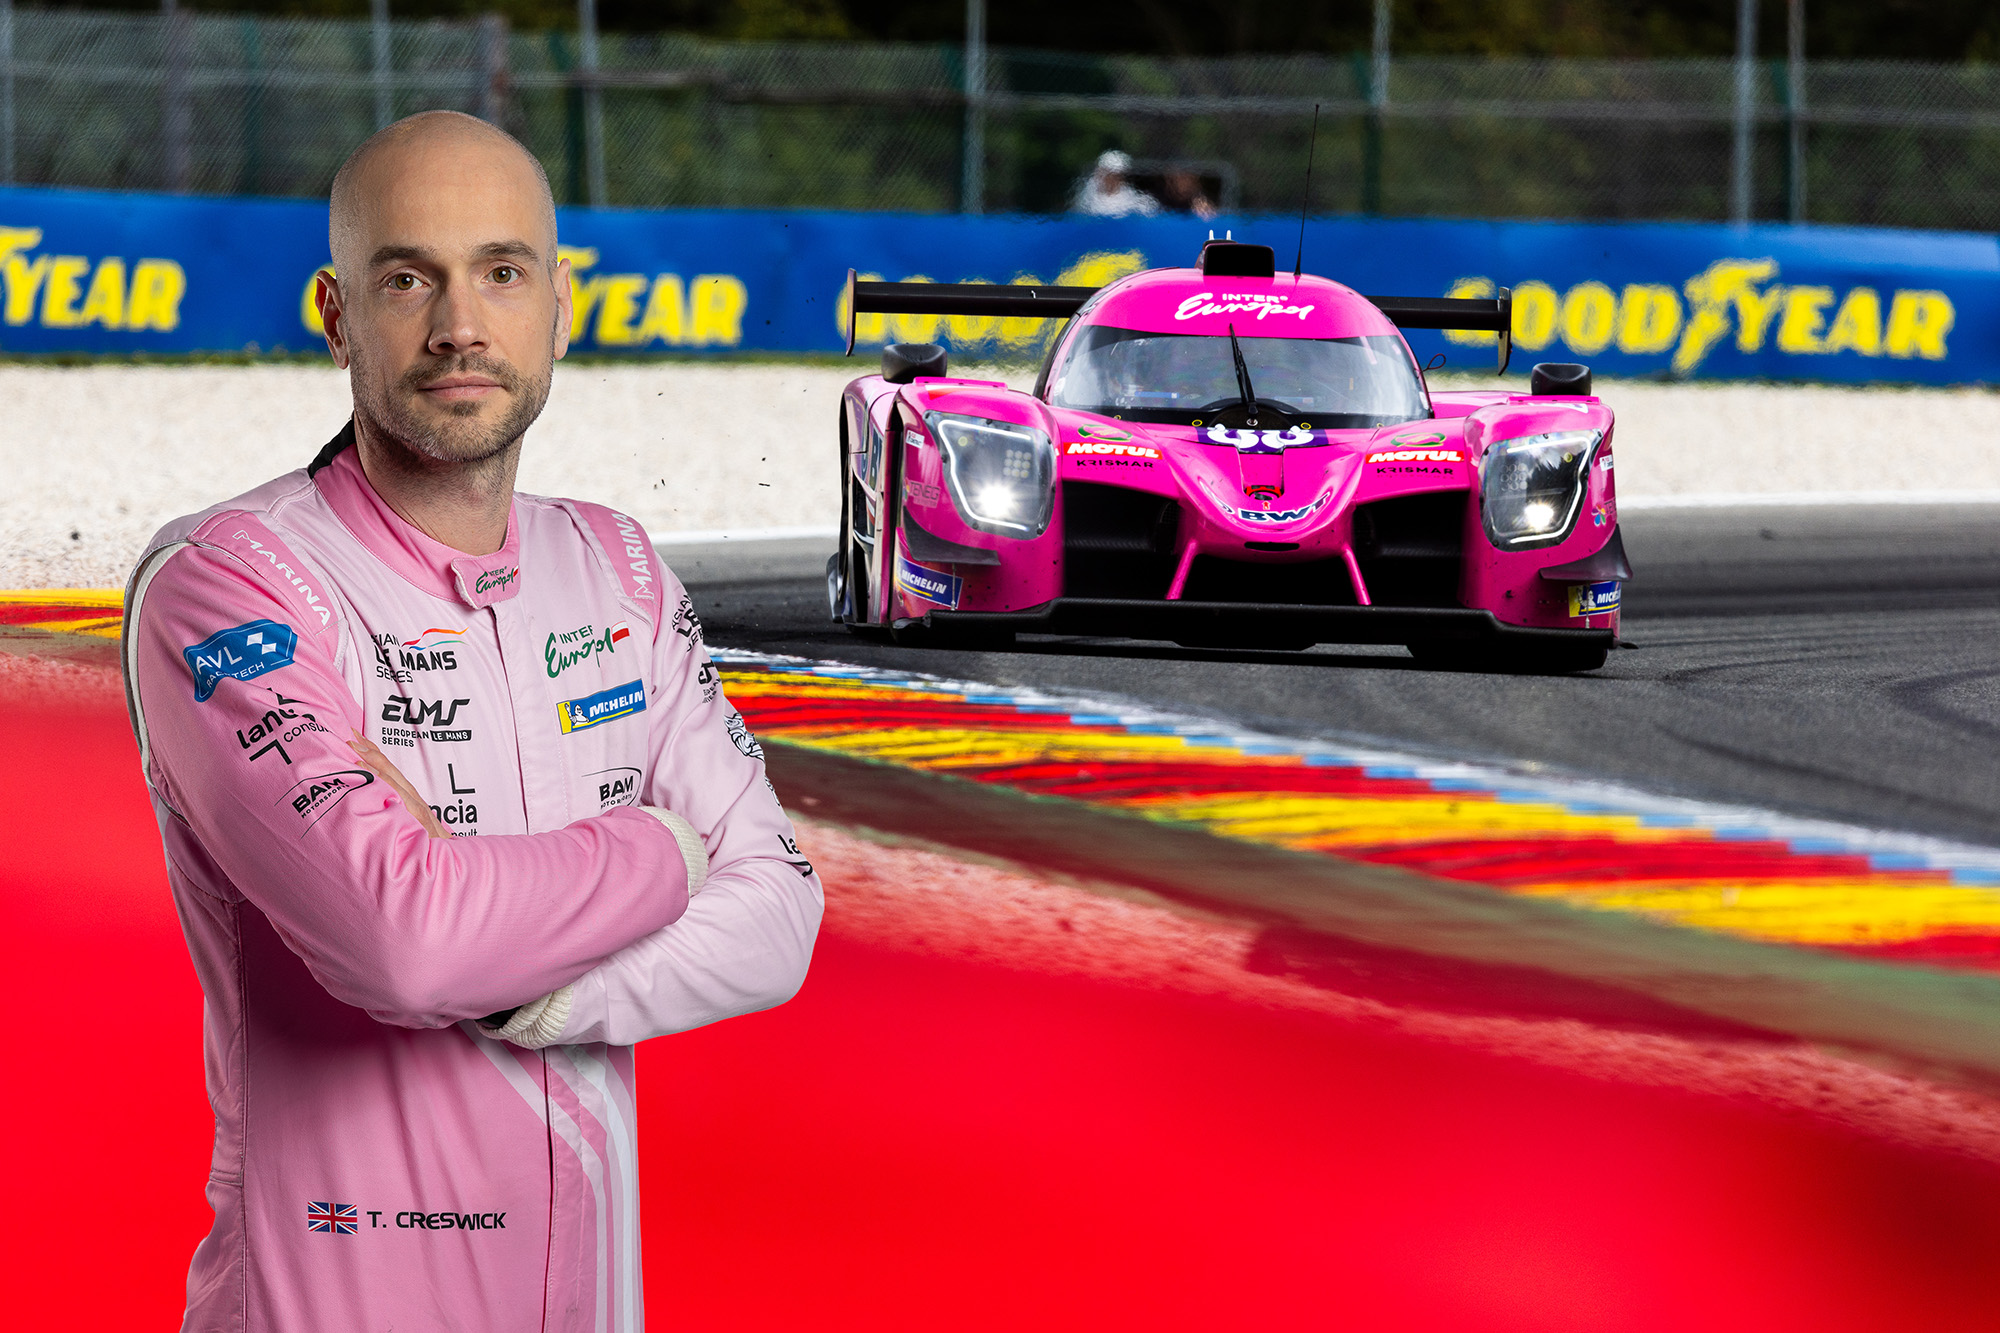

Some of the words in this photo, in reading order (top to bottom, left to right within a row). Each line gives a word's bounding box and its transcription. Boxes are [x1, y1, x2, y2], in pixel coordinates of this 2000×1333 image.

[1067, 443, 1159, 458] MOTUL
[1368, 450, 1462, 462] MOTUL
[1077, 460, 1154, 468] KRISMAR
[1377, 467, 1454, 475] KRISMAR
[1238, 492, 1331, 522] BWT
[611, 513, 655, 600] MARINA
[232, 530, 331, 626] MARINA
[901, 570, 947, 594] MICHELIN
[196, 646, 243, 675] AVL
[399, 649, 458, 671] MANS
[382, 727, 429, 739] EUROPEAN
[432, 733, 443, 741] LE
[445, 731, 469, 741] MANS
[382, 736, 414, 747] SERIES
[292, 778, 345, 813] BAM
[599, 775, 634, 801] BAM
[367, 1211, 387, 1228] T.
[396, 1211, 507, 1231] CRESWICK
